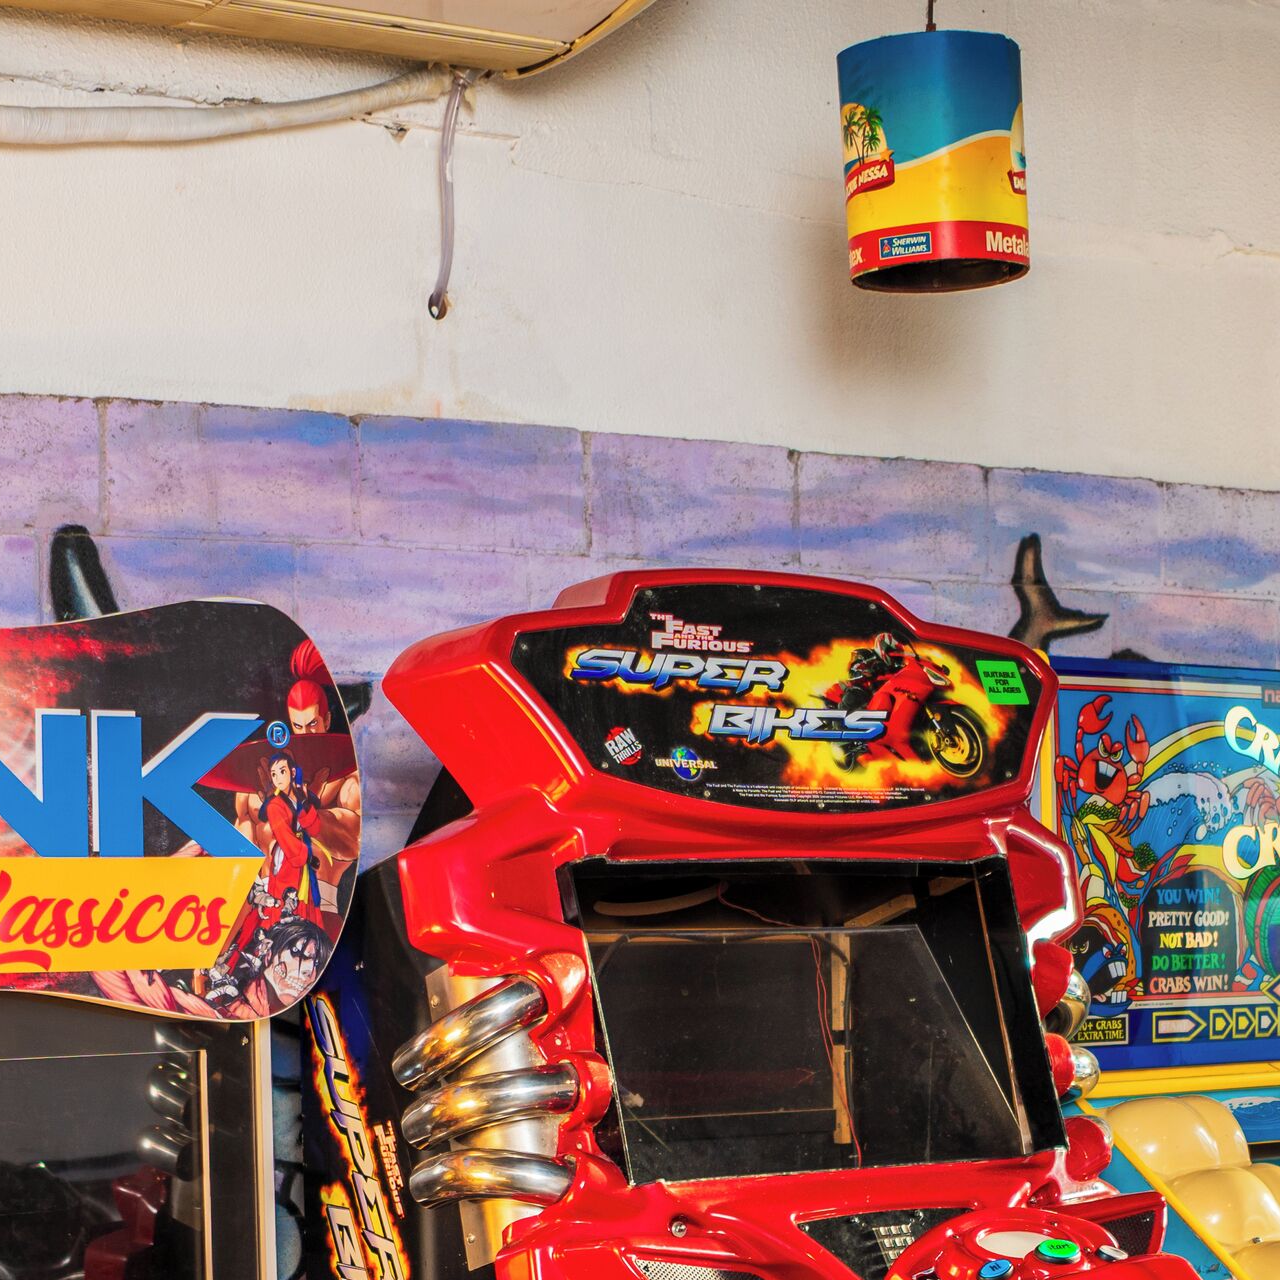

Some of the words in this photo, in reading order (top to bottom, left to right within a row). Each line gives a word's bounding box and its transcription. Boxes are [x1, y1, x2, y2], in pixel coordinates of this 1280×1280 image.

[891, 244, 928, 256] WILLIAMS
[892, 234, 927, 247] SHERWIN
[666, 614, 723, 637] FAST
[651, 631, 751, 653] FURIOUS
[570, 647, 789, 694] SUPER
[982, 671, 1017, 679] SUITABLE
[988, 686, 1002, 694] ALL
[1003, 686, 1022, 694] AGES
[706, 704, 891, 744] BIKES
[604, 727, 637, 757] RAW
[612, 740, 642, 765] THRILLS
[654, 758, 719, 770] UNIVERSAL
[1155, 888, 1183, 905] YOU
[1184, 887, 1221, 905] WIN!
[1147, 910, 1192, 929] PRETTY
[1193, 909, 1231, 927] GOOD!
[1159, 933, 1184, 950] NOT
[1185, 931, 1219, 949] BAD!
[1151, 955, 1170, 972] DO
[1171, 952, 1226, 971] BETTER!
[1149, 975, 1192, 994] CRABS
[1193, 974, 1230, 992] WIN!
[1095, 1018, 1122, 1031] CRABS
[1077, 1030, 1104, 1041] EXTRA
[1105, 1029, 1124, 1040] TIME
